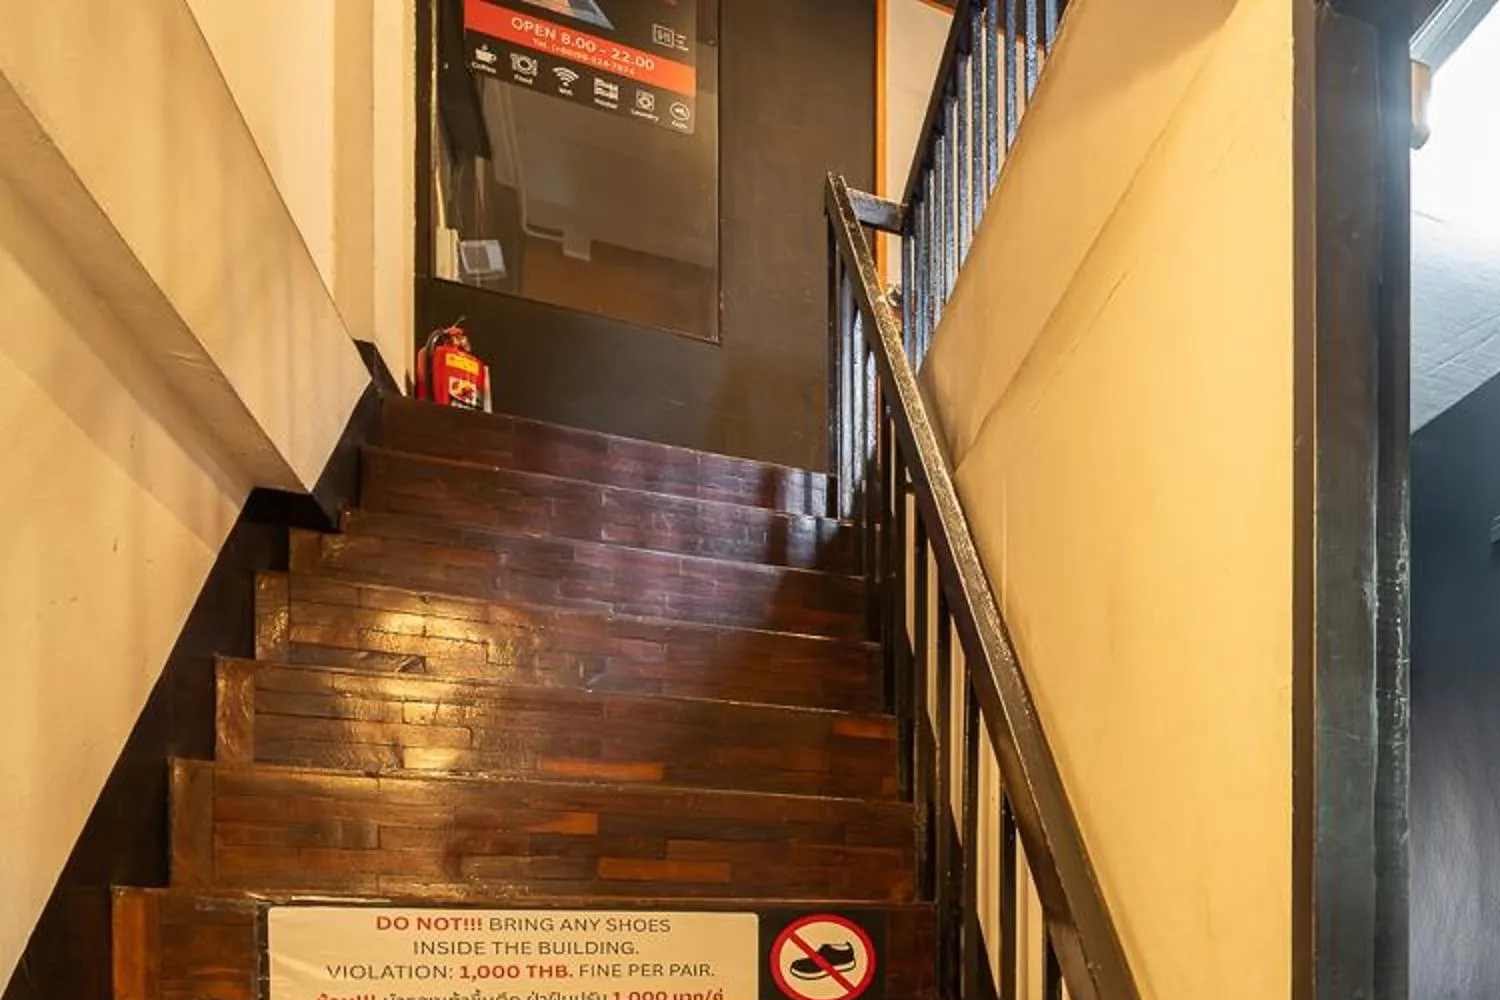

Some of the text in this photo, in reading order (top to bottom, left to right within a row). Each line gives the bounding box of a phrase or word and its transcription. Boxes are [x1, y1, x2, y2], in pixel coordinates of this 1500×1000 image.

[511, 16, 557, 41] OPEN
[561, 31, 597, 54] 8.00
[611, 47, 656, 71] 22.00
[376, 915, 671, 933] DO NOT!!! BRING ANY SHOES
[413, 941, 640, 955] INSIDE THE BUILDING.
[326, 963, 715, 984] VIOLATION: 1,000 THB. FINE PER PAIR.
